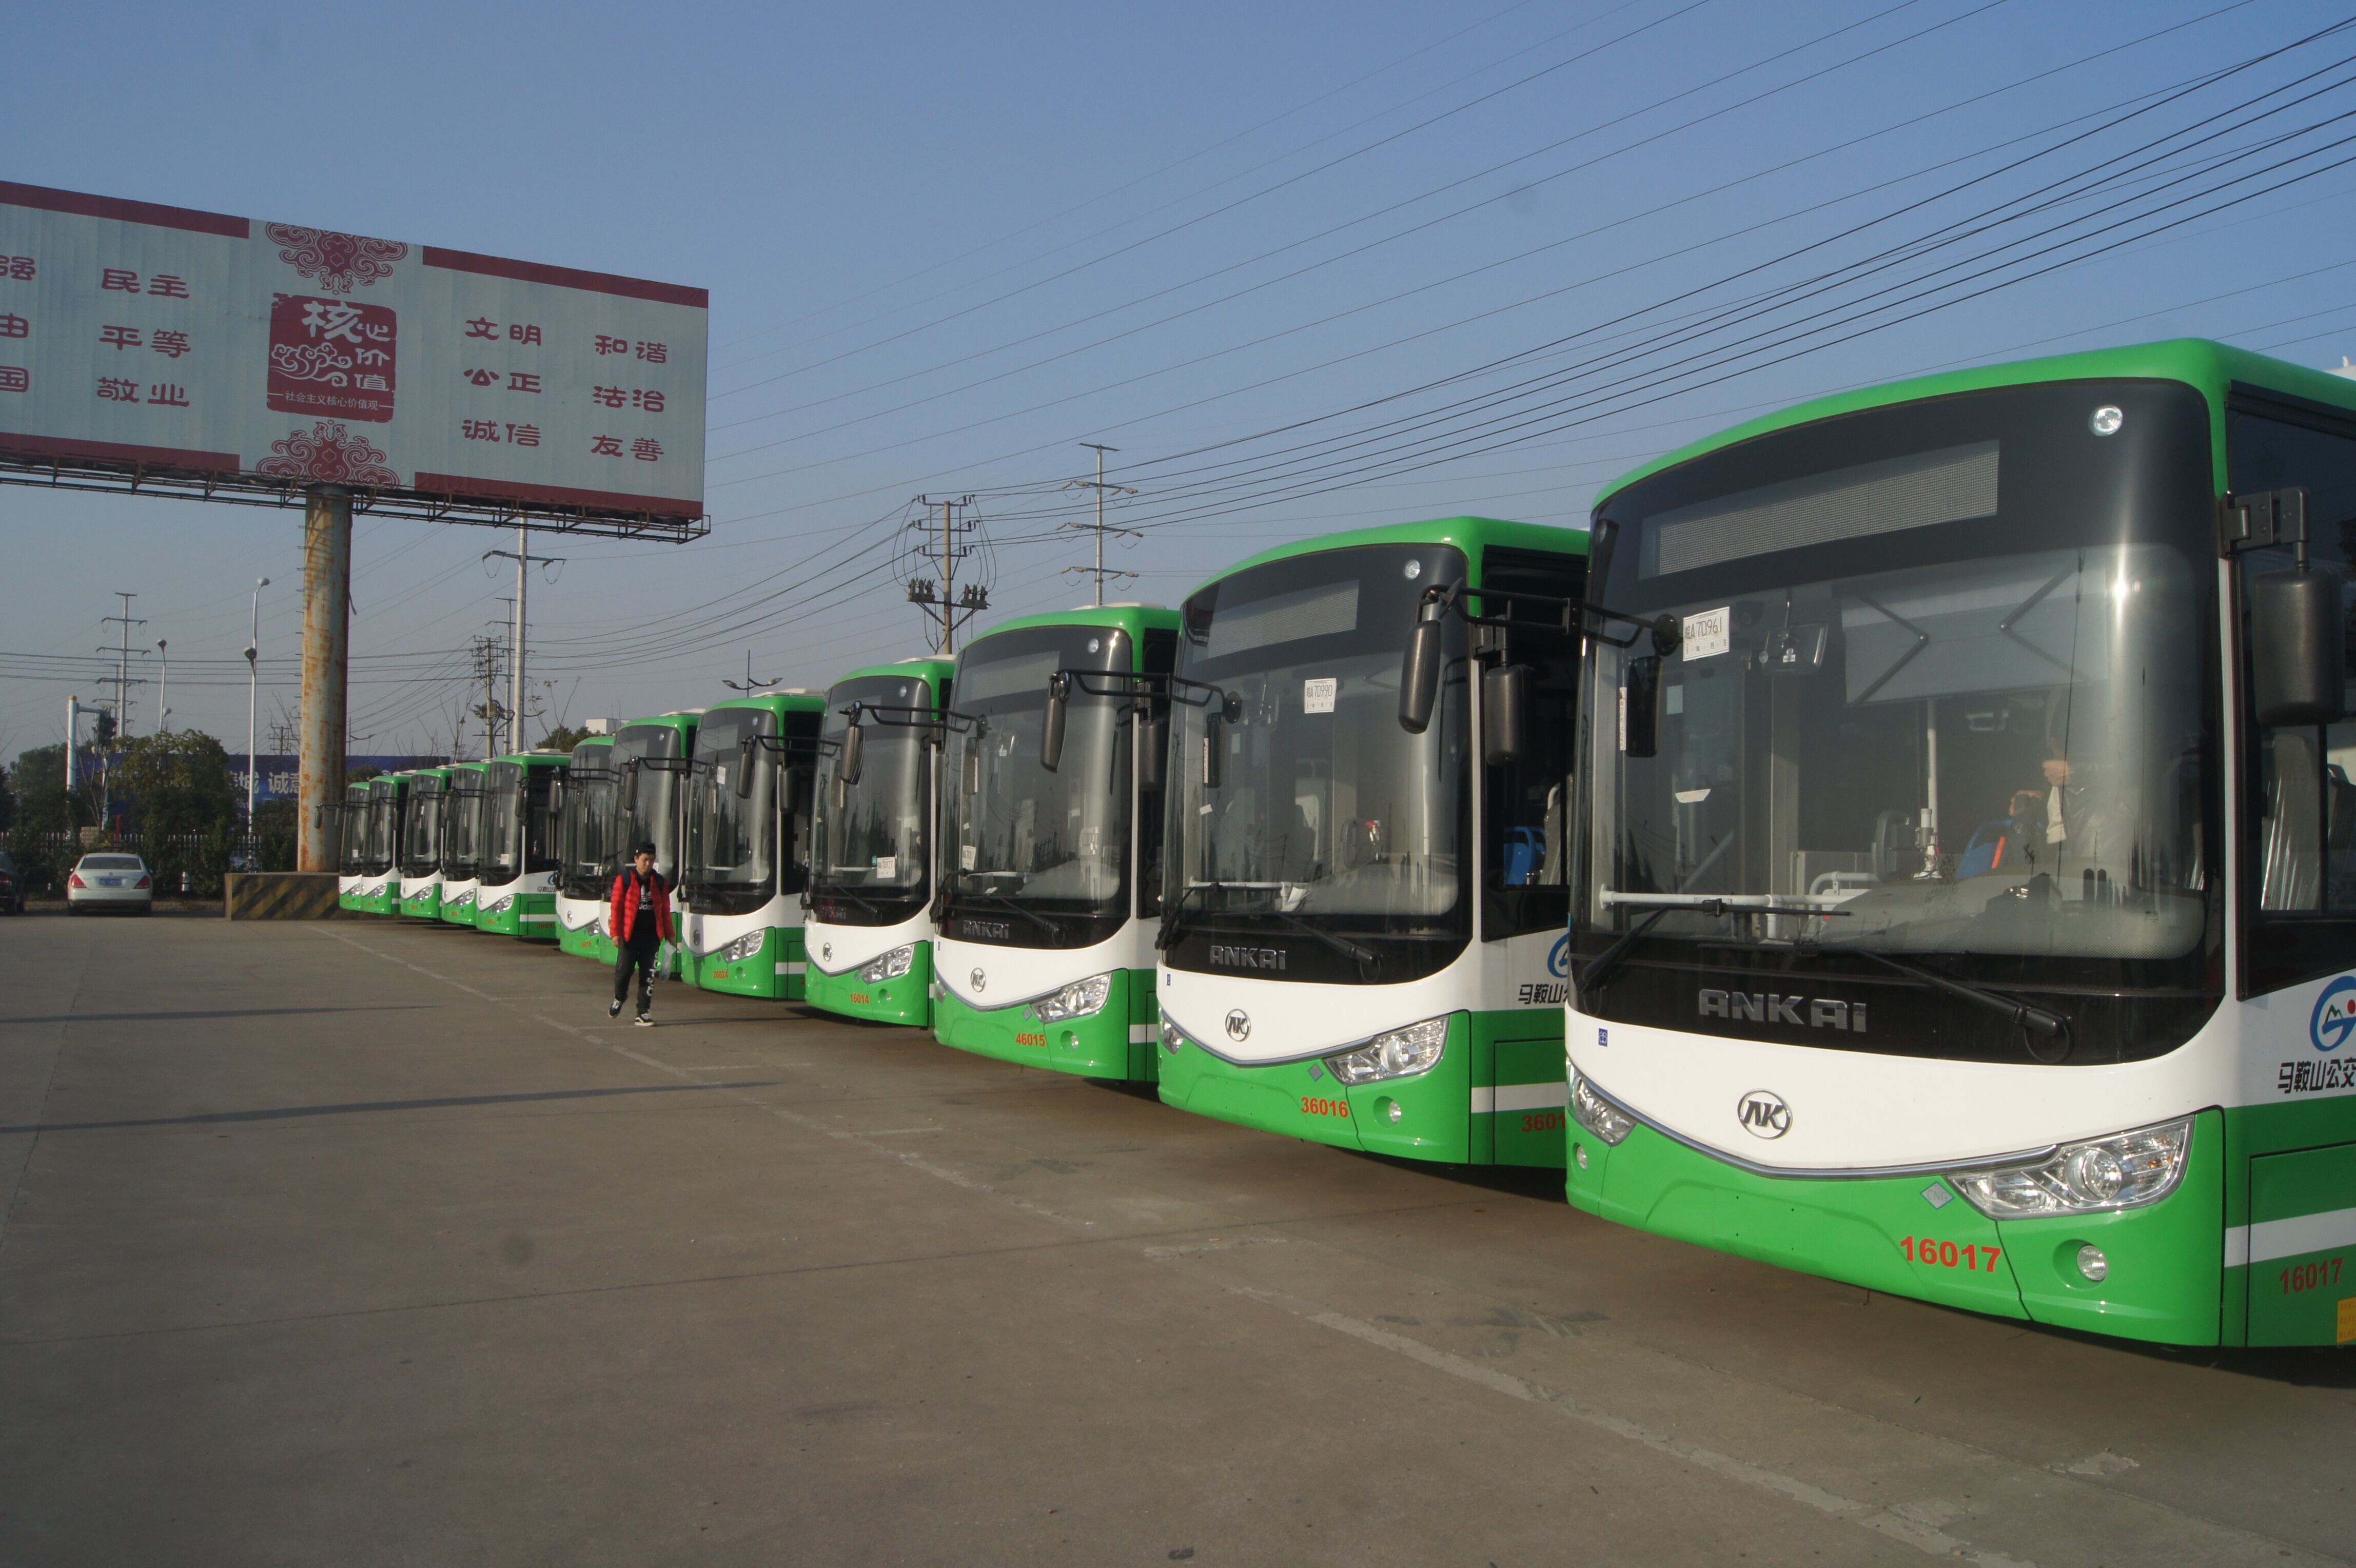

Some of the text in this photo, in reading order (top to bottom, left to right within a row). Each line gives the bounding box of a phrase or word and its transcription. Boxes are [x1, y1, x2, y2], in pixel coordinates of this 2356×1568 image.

[102, 268, 190, 299] 民主
[99, 325, 191, 358] 平等
[465, 317, 542, 346] 文明
[595, 335, 667, 364] 和谐
[97, 377, 190, 407] 敬业
[464, 368, 542, 394] 公正
[285, 390, 378, 410] 社会主义核心价值观
[593, 385, 665, 413] 法治
[462, 419, 542, 447] 诚信
[591, 435, 664, 462] 友善
[963, 920, 1009, 939] ANKAI
[1210, 946, 1286, 970] ANKAI
[850, 993, 870, 1004] 16014
[1699, 989, 1866, 1032] ANKAI
[1016, 1033, 1046, 1047] 46015
[2278, 1057, 2356, 1094] 马鞍山公交
[1301, 1096, 1349, 1118] 36016
[1522, 1112, 1565, 1132] 3601
[1900, 1236, 2001, 1272] 16017
[2280, 1258, 2344, 1295] 16017
